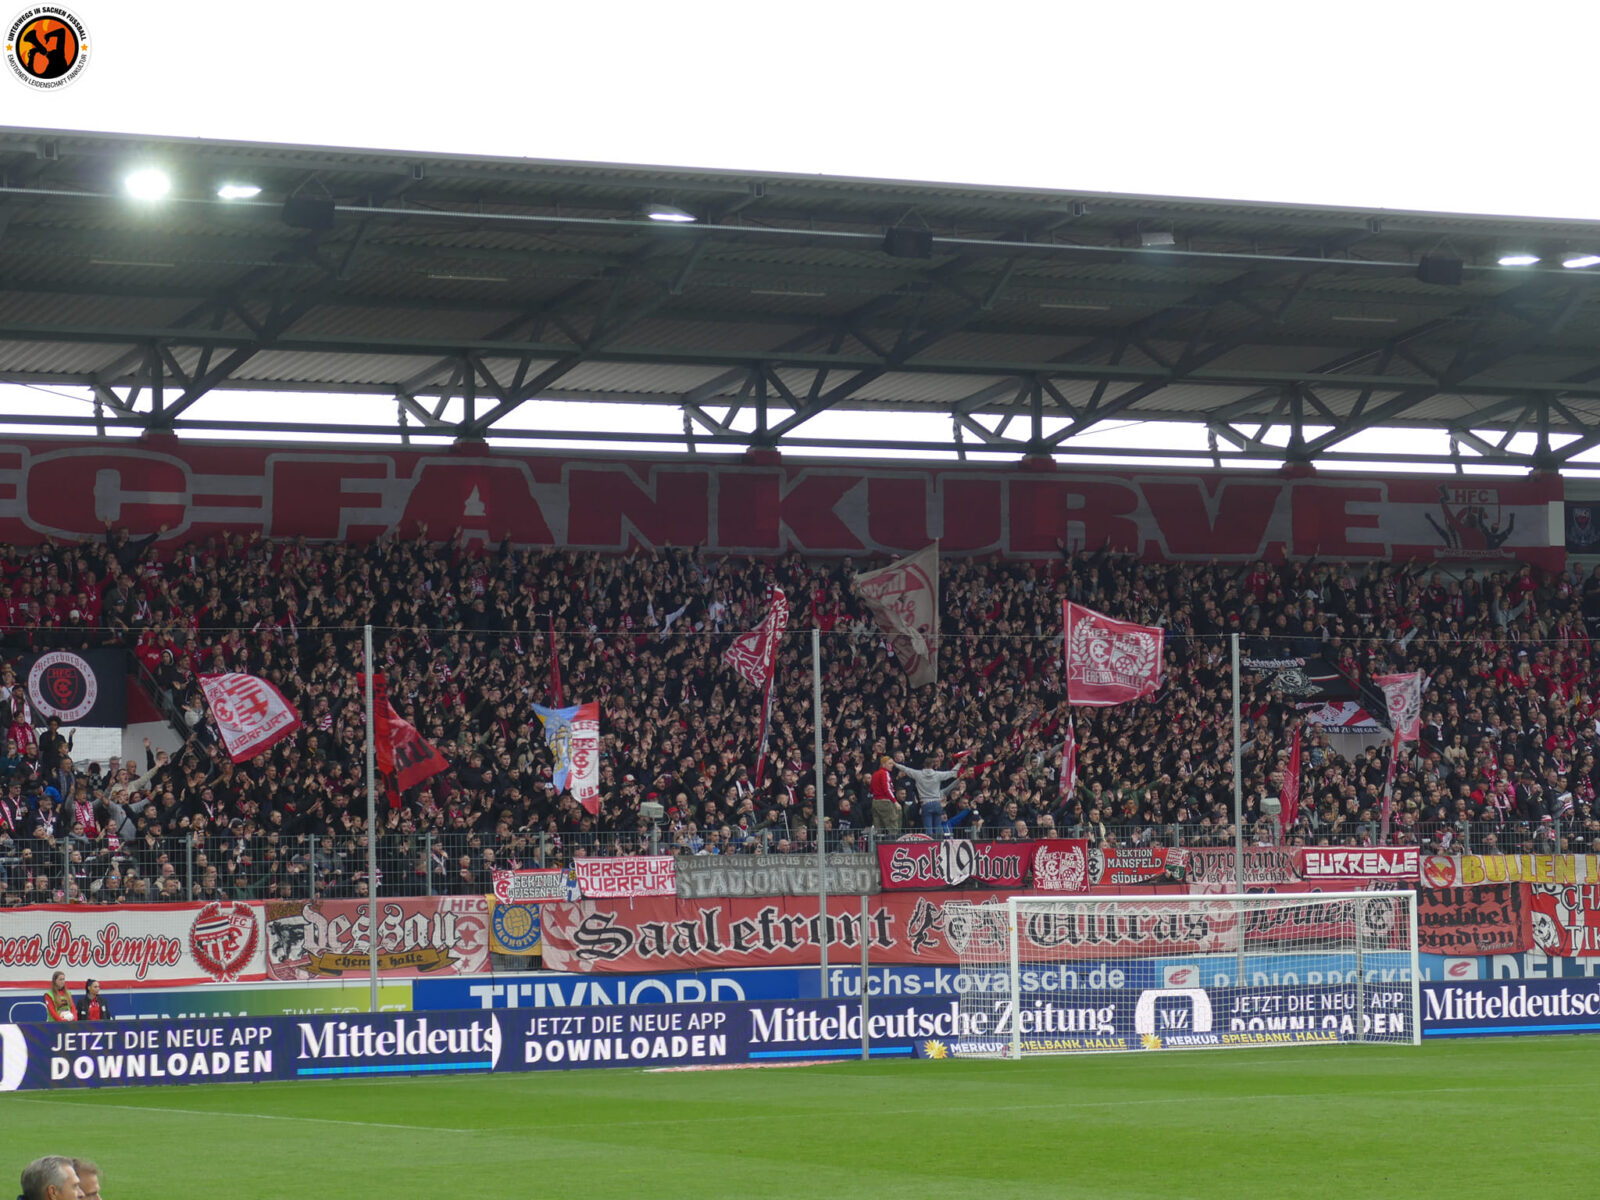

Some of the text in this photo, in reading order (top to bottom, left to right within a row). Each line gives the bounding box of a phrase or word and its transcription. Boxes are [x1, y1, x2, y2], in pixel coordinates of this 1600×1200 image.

[1455, 489, 1489, 503] HFC
[1107, 858, 1162, 868] MANSFELD
[1116, 848, 1153, 858] SEKTION
[1305, 852, 1418, 874] SURREALE
[1461, 853, 1577, 884] BULLEN
[514, 875, 560, 888] SEKTION
[577, 874, 676, 892] QUERFURT
[1561, 885, 1600, 913] CH
[495, 918, 539, 947] LOKOMOTIVE
[573, 903, 1211, 961] Saalefront Ultras
[45, 921, 92, 968] Per
[94, 922, 182, 982] Sempre
[390, 953, 424, 968] halle
[829, 965, 1125, 998] fuchs-kovatsch.de
[1231, 996, 1282, 1013] JETZT
[1288, 995, 1316, 1011] DIE
[1370, 992, 1404, 1008] APP
[1423, 983, 1600, 1021] Mitteldeutsc
[526, 1011, 726, 1036] JETZT DIE NEUE APP
[749, 1000, 1115, 1043] Mitteldeutsche Zeitung
[1160, 1009, 1189, 1030] MZ
[51, 1027, 272, 1051] JETZT DIE NEUE APP
[525, 1034, 727, 1063] DOWNLOADEN
[950, 1041, 1003, 1053] MERKUR
[1084, 1037, 1127, 1049] HALLE
[1166, 1030, 1338, 1046] MERKUR SPIELBANK HALLE
[50, 1050, 273, 1080] DOWNLOADEN
